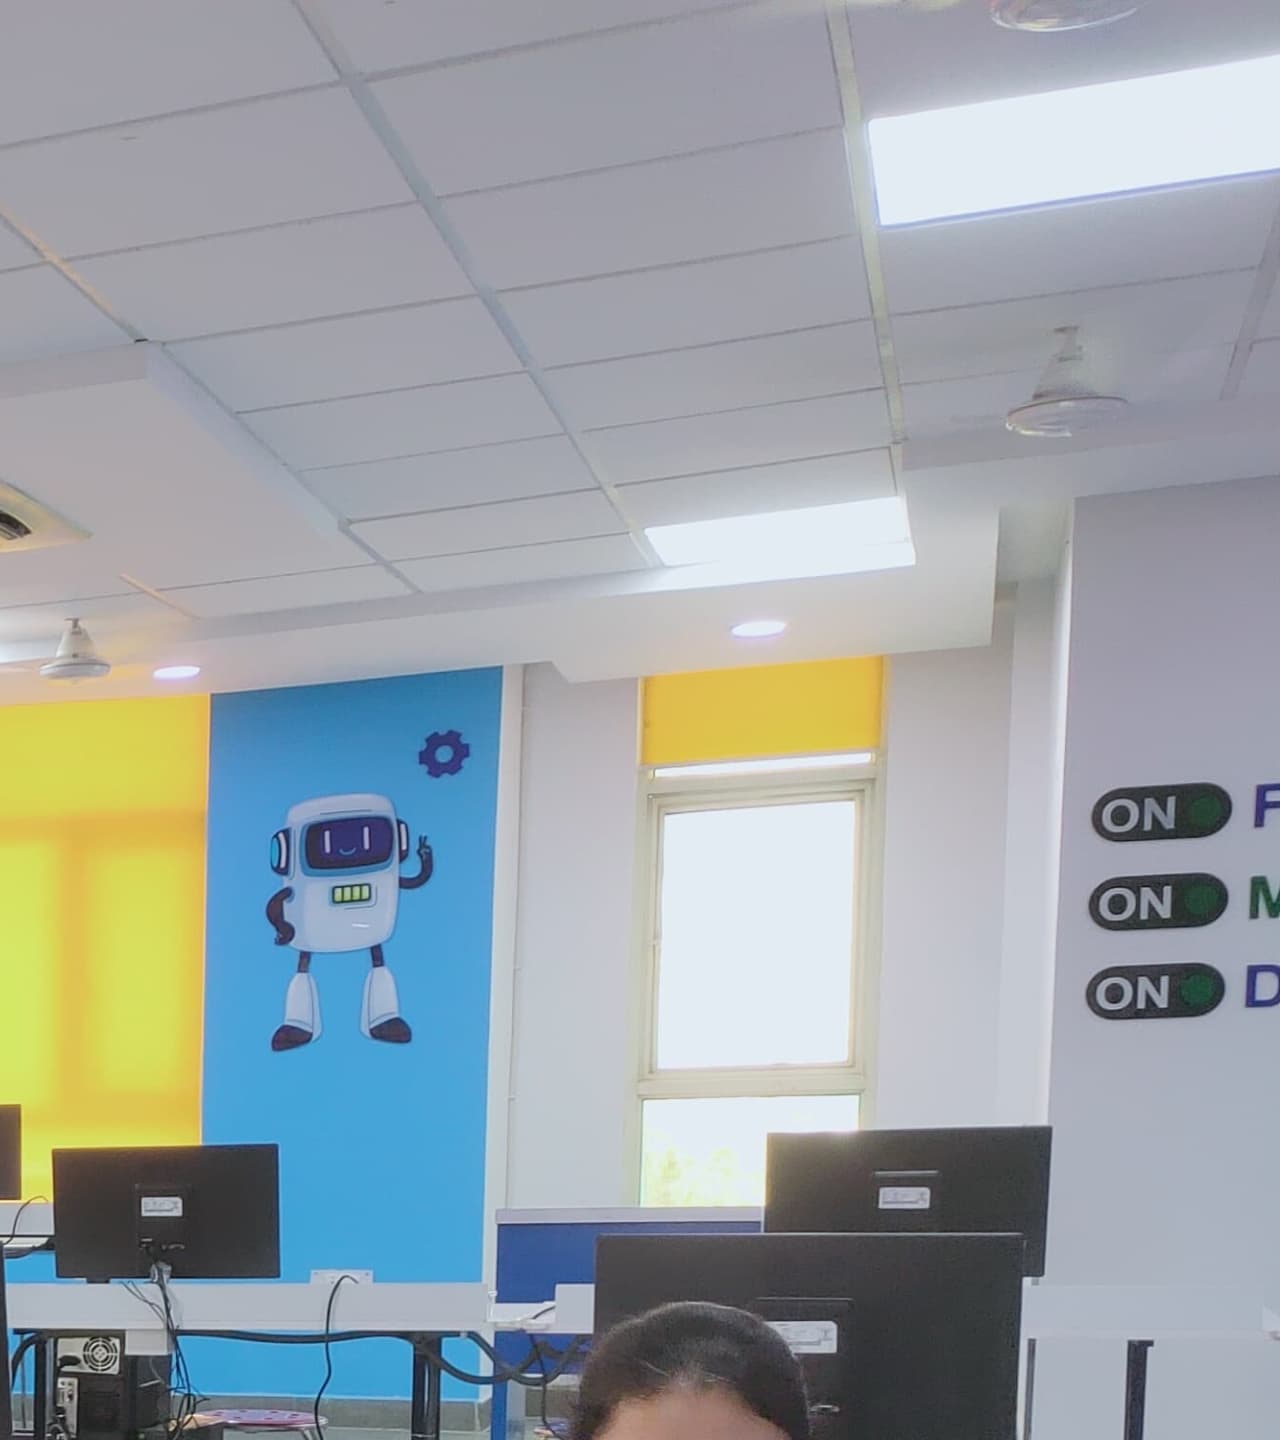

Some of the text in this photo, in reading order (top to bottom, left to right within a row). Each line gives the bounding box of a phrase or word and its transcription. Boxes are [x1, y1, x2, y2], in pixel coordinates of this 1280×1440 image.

[1101, 796, 1177, 833] ON
[1098, 885, 1172, 921] ON
[1095, 975, 1169, 1011] ON
